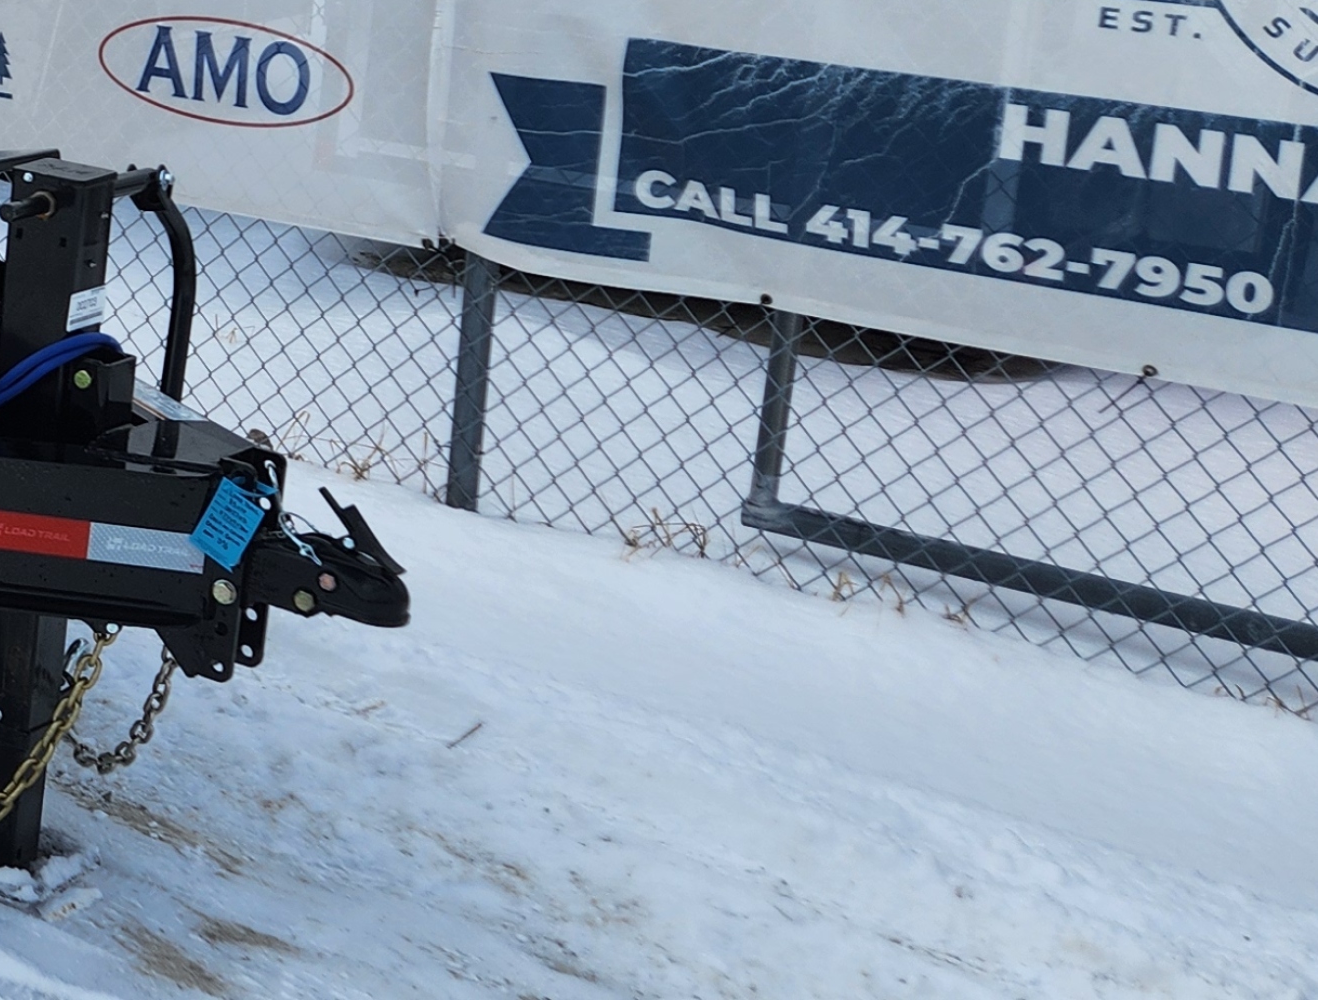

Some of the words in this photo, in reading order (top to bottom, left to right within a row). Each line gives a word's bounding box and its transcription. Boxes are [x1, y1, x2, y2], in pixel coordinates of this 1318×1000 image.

[1098, 6, 1202, 40] EST.
[135, 25, 310, 116] AMO
[999, 102, 1318, 204] HANN
[634, 169, 788, 235] CALL
[806, 204, 1274, 315] 414-762-7950
[4, 526, 36, 538] LOAD
[37, 530, 71, 542] TRAIL
